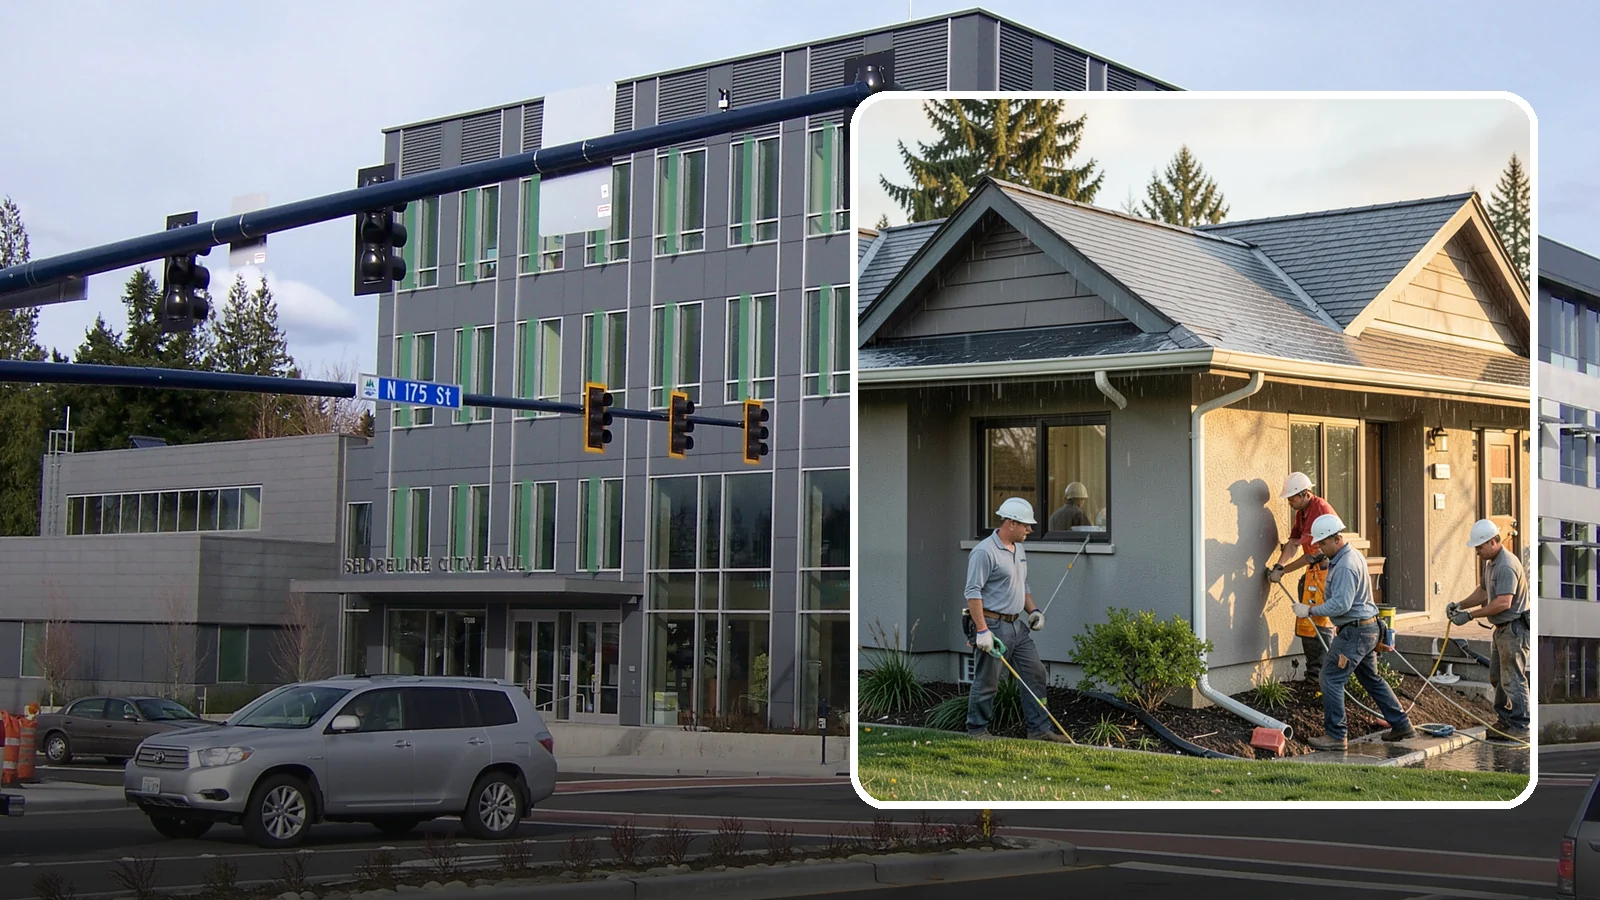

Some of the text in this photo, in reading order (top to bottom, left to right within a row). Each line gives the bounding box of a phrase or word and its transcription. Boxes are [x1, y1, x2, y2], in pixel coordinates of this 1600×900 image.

[387, 380, 451, 406] N 175 St
[344, 555, 525, 574] SHORELINE CITY HALL
